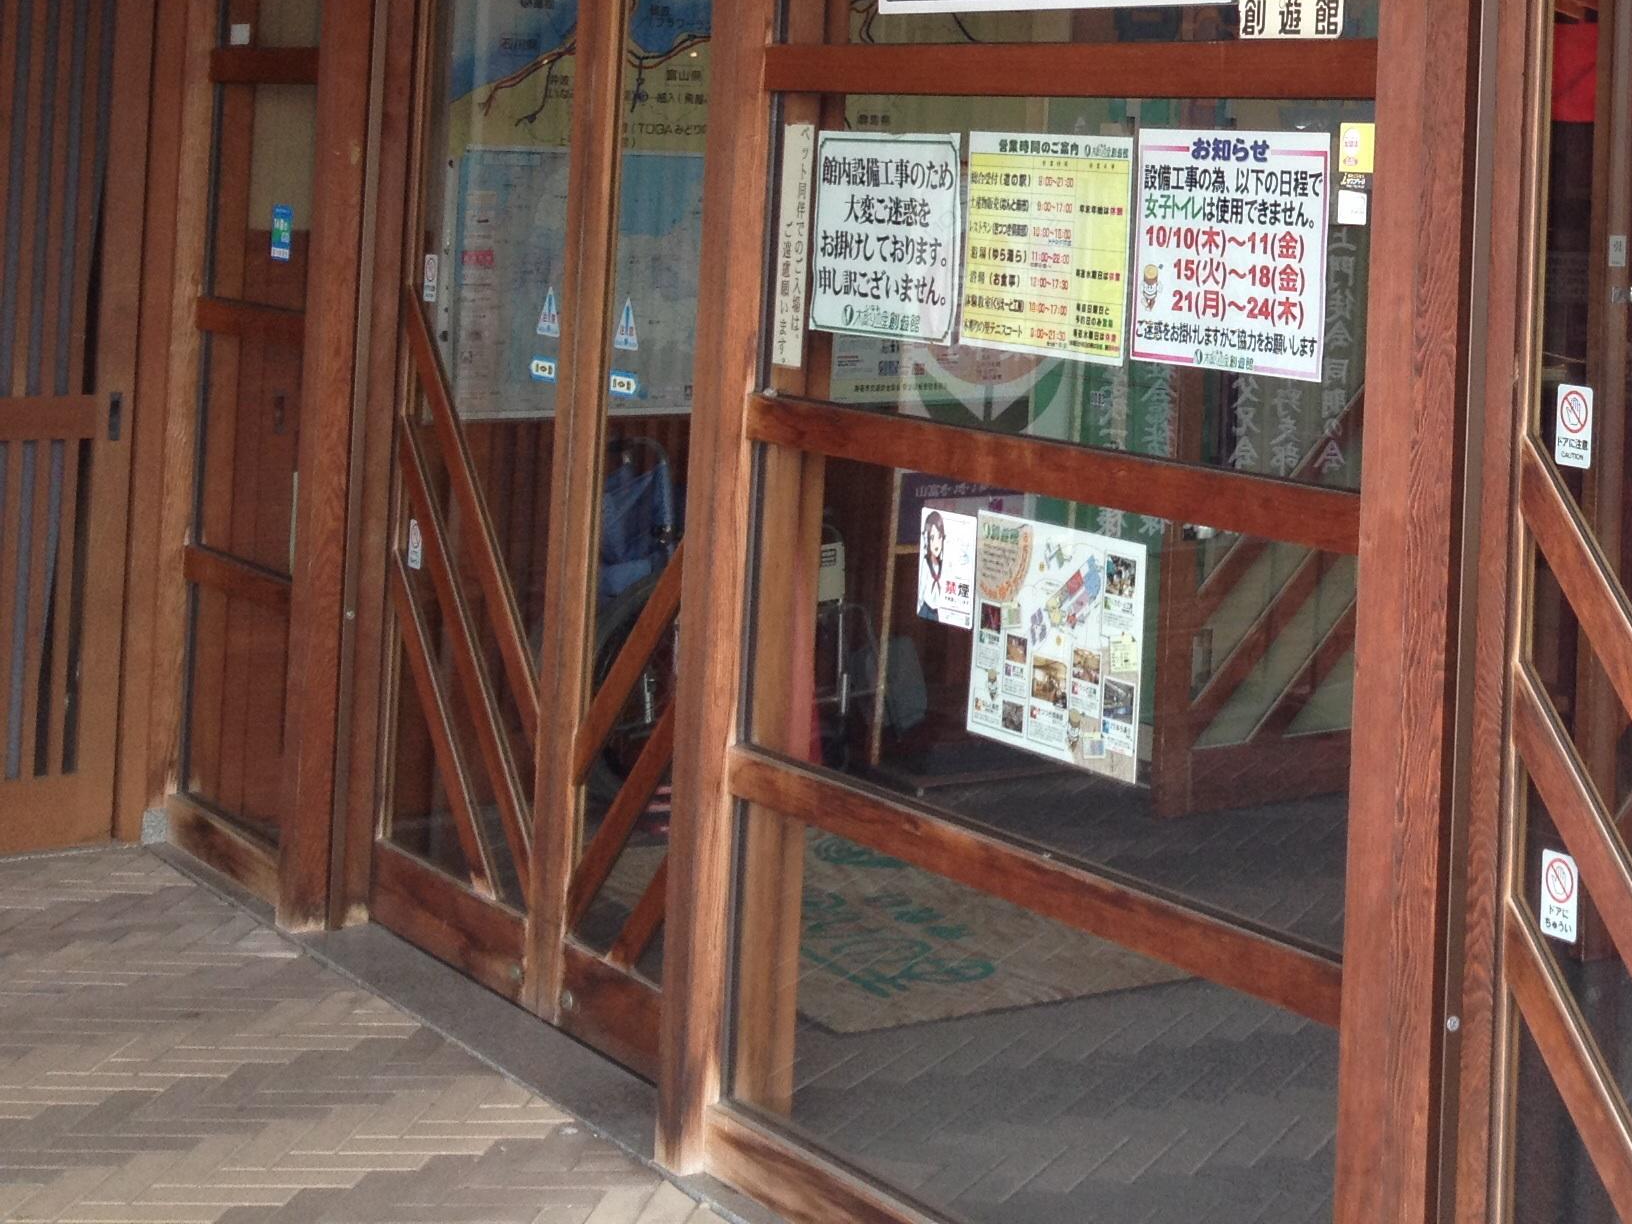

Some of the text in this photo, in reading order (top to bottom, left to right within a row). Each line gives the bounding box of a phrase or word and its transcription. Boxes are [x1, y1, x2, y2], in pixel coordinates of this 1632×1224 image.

[999, 139, 1079, 156] 営業時間のご案内
[1191, 137, 1270, 162] お知らせ
[822, 155, 954, 190] 館内設備工事のため
[1144, 164, 1323, 198] 設備工事の為、以下の日程で
[844, 194, 931, 228] 大変ご迷惑を
[1144, 193, 1315, 229] 女子トイレは使用できません。
[820, 229, 948, 269] お掛けしております。
[818, 266, 947, 307] 申し訳ございません。
[1136, 320, 1317, 357] ご迷惑をお掛けしますがご協力をお願いします
[944, 579, 970, 599] 禁煙
[1545, 917, 1572, 934] ちゅうい
[1549, 903, 1569, 919] ドアに
